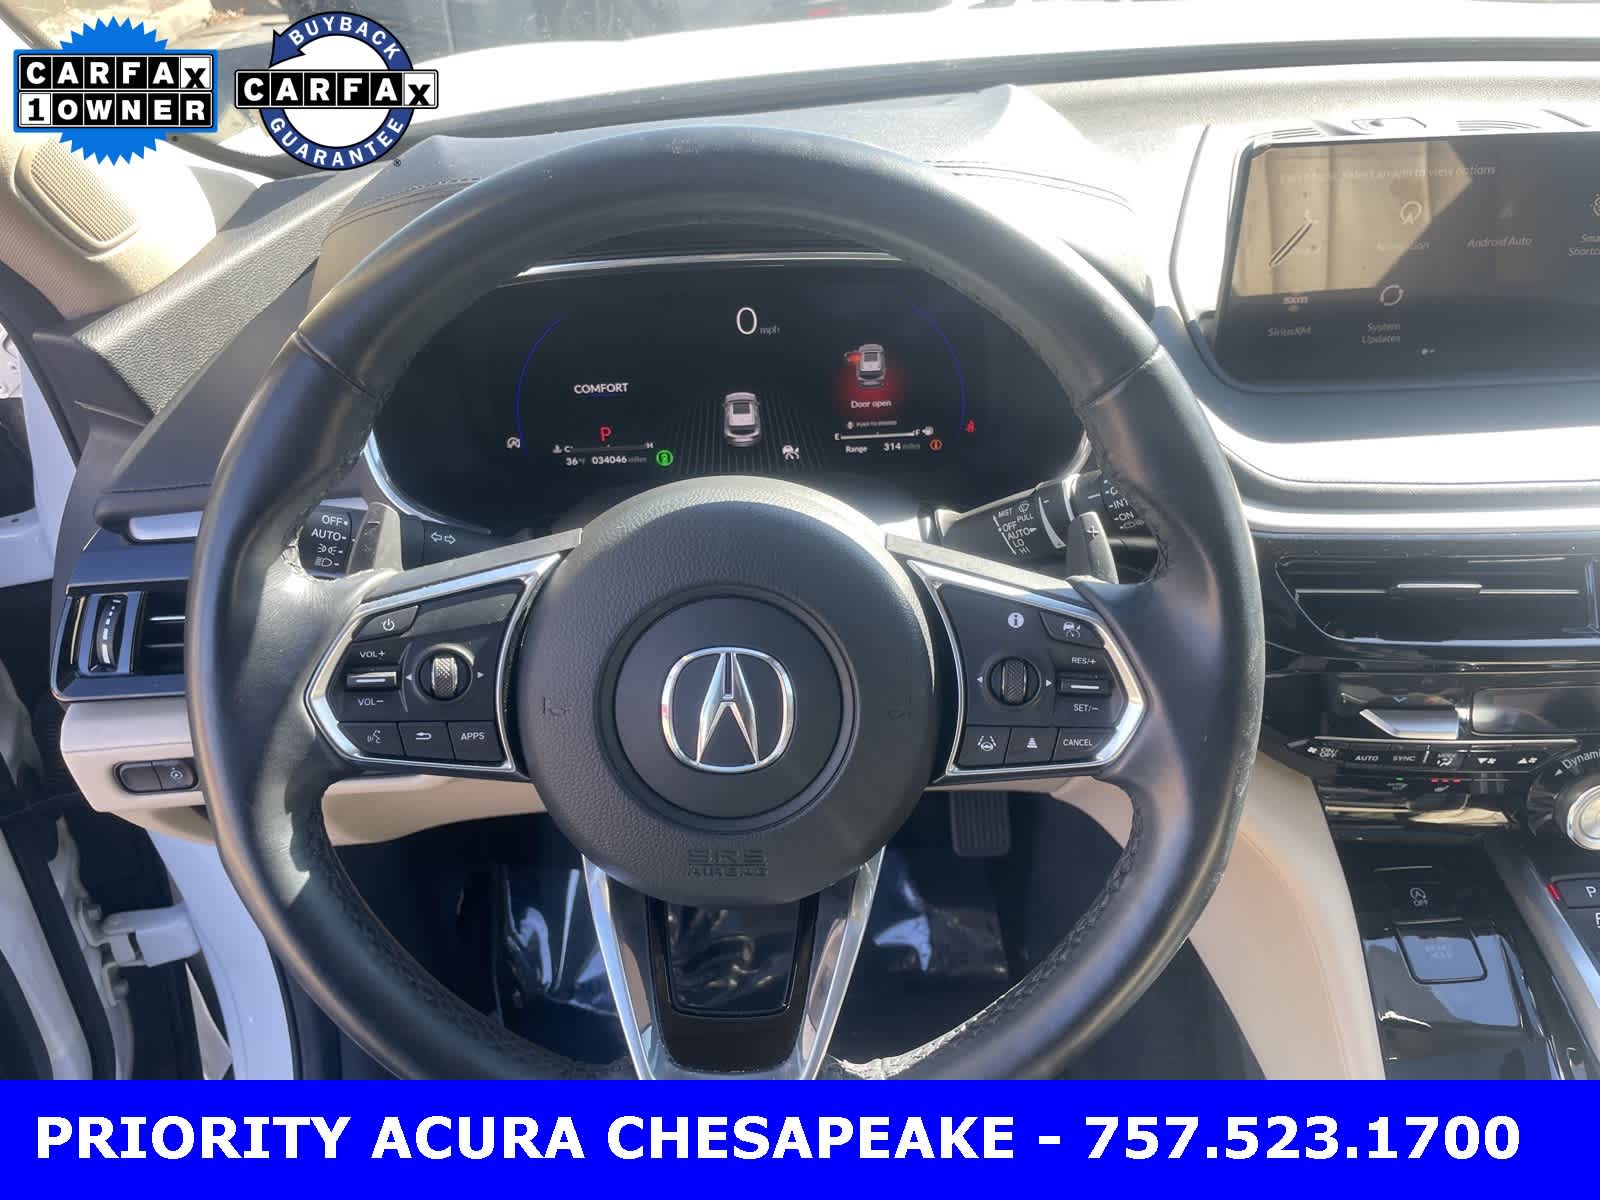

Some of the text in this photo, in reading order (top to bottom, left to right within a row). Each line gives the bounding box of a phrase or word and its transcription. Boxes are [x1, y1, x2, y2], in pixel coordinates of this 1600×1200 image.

[1455, 166, 1496, 177] options
[736, 307, 780, 336] 0 mph
[1267, 326, 1312, 337] SiriusXM
[1367, 322, 1400, 333] System
[574, 383, 629, 394] COMFORT
[872, 400, 891, 408] open
[600, 427, 612, 441] P
[846, 446, 868, 454] Range
[883, 442, 901, 451] 314
[592, 456, 627, 465] 034046
[321, 515, 344, 527] OFF
[1017, 514, 1034, 523] PULL
[1002, 520, 1017, 532] OFF
[311, 528, 342, 541] AUTO
[1007, 527, 1031, 540] AUTO
[1012, 540, 1025, 548] LO
[359, 650, 385, 658] VOL+
[1071, 656, 1097, 665] RES/+
[460, 732, 485, 741] APPS
[1063, 738, 1093, 747] CANCEL
[1585, 886, 1596, 898] P
